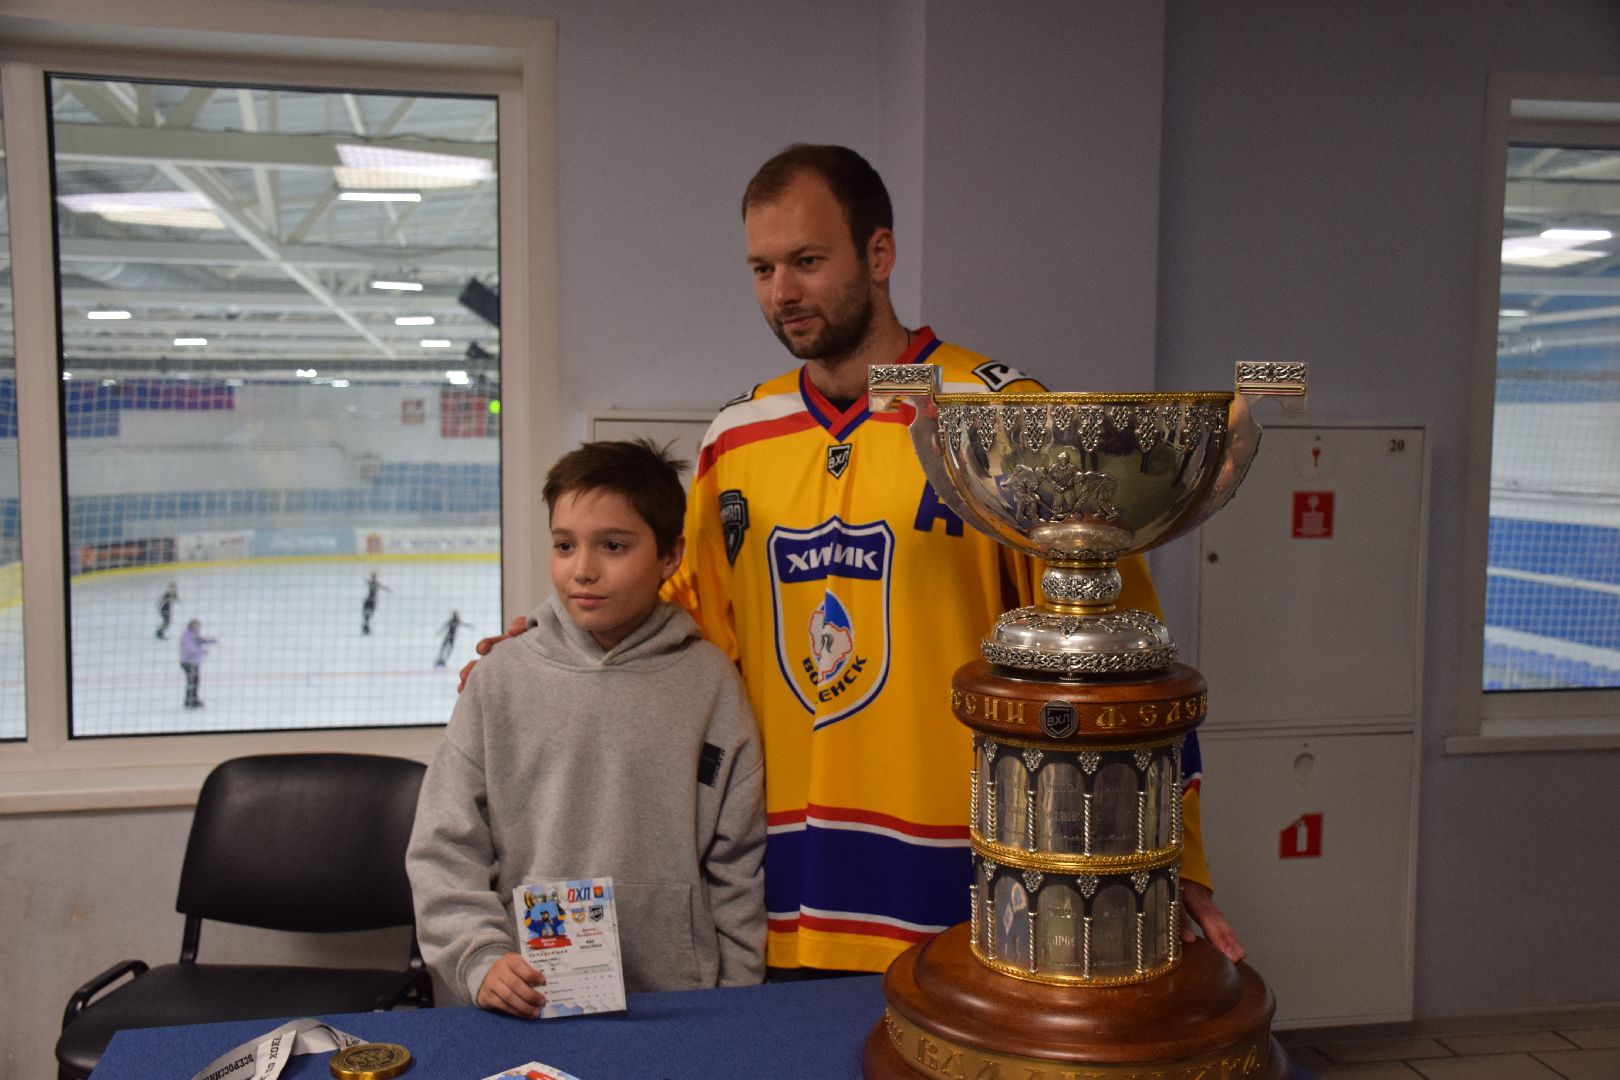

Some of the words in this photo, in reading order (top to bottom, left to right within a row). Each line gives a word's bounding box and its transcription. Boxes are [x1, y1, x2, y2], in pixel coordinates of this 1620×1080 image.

[1390, 438, 1405, 452] 20
[828, 450, 849, 468] ВХЛ
[1047, 712, 1069, 728] ВХЛ
